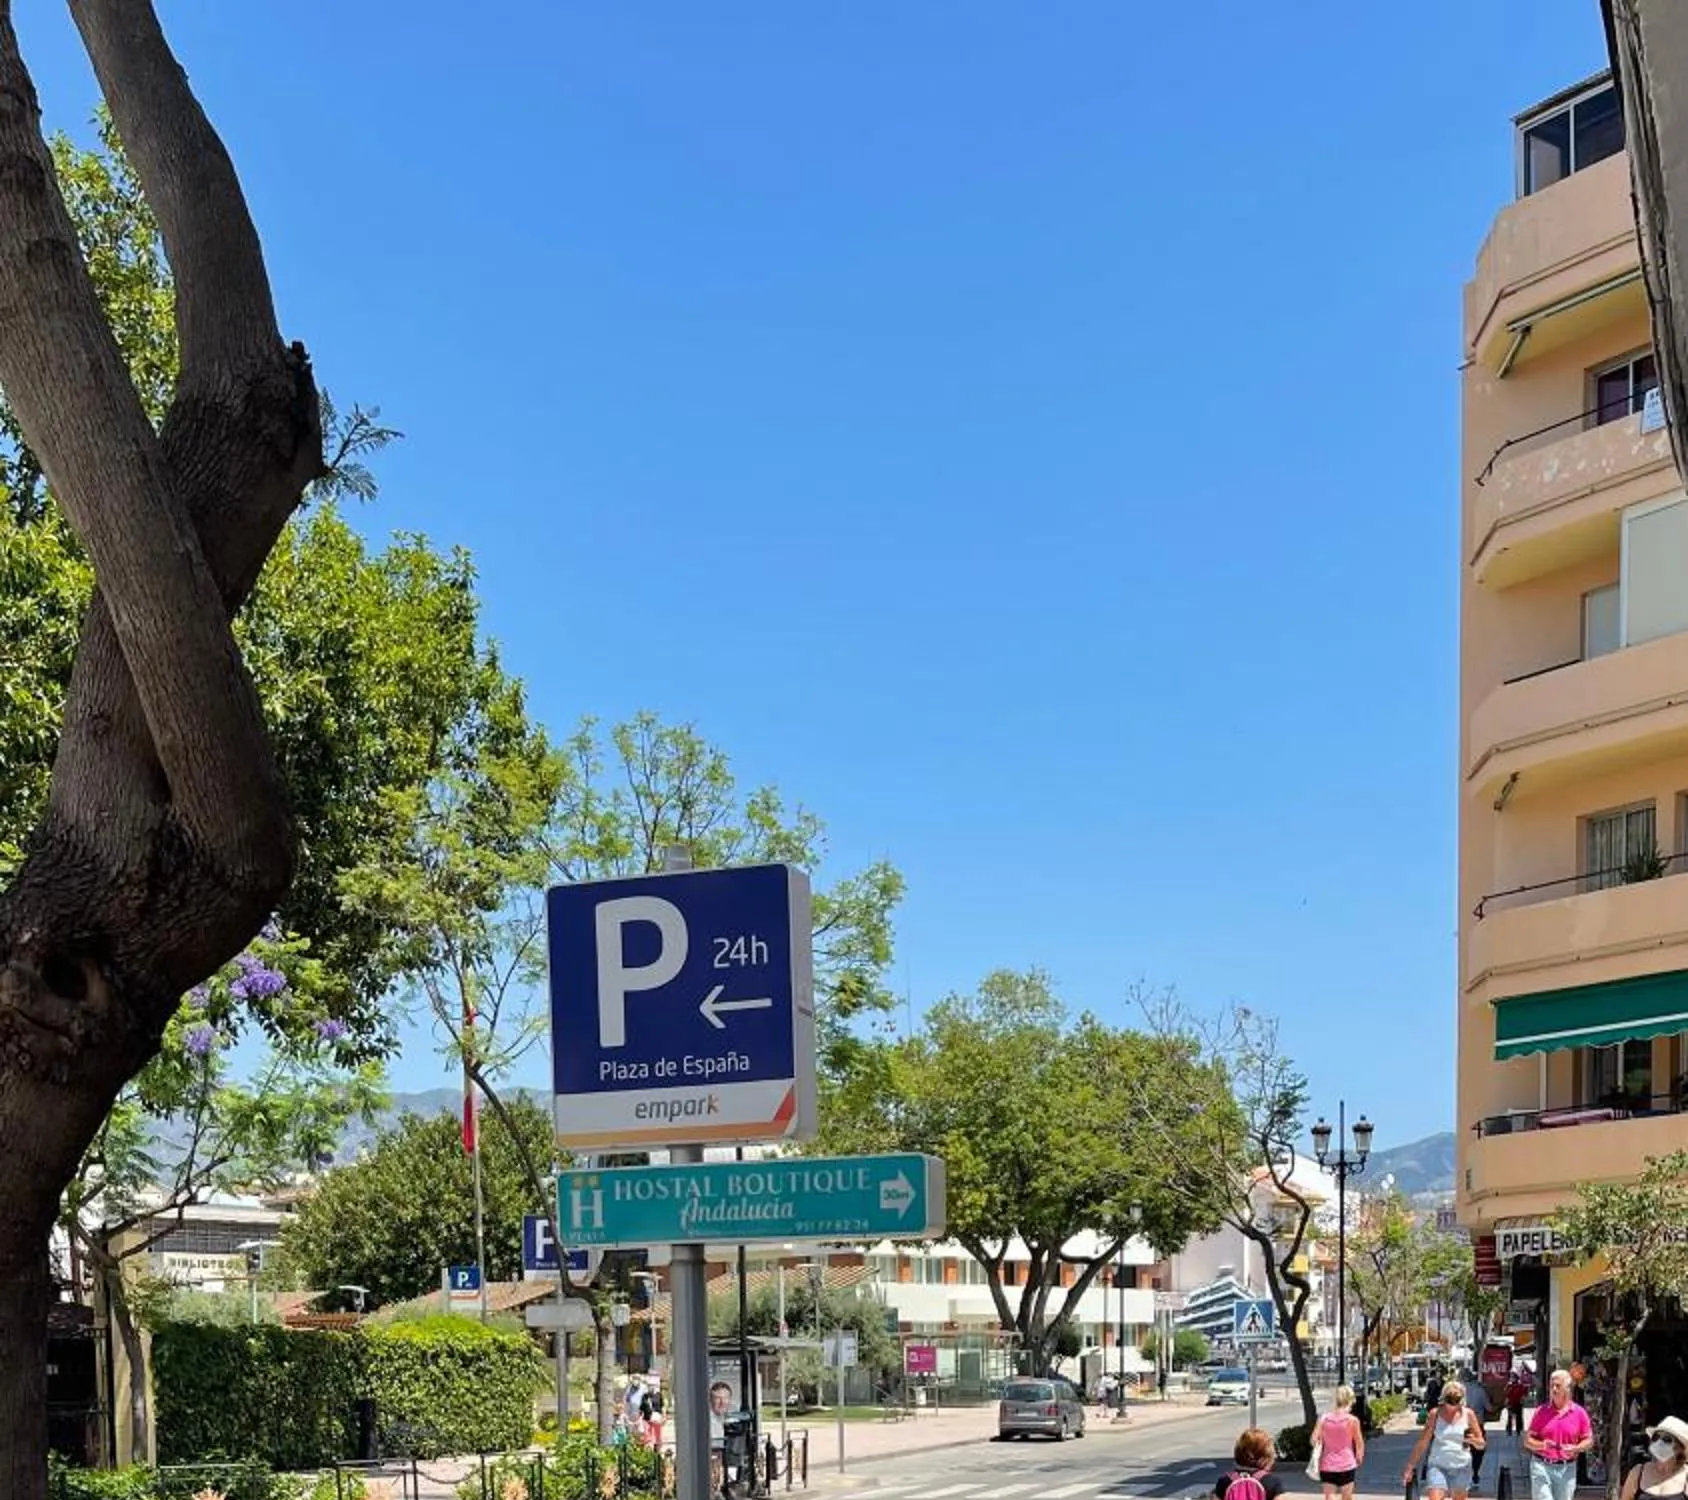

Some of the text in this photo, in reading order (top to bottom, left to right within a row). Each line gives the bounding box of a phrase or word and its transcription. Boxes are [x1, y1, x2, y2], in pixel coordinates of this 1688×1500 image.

[713, 934, 769, 969] 24h
[595, 895, 689, 1048] P
[600, 1051, 750, 1080] Plaza de España
[635, 1094, 720, 1122] empark
[615, 1168, 872, 1200] HOSTAL BOUTIQUE
[571, 1188, 605, 1229] H
[457, 1271, 469, 1288] P
